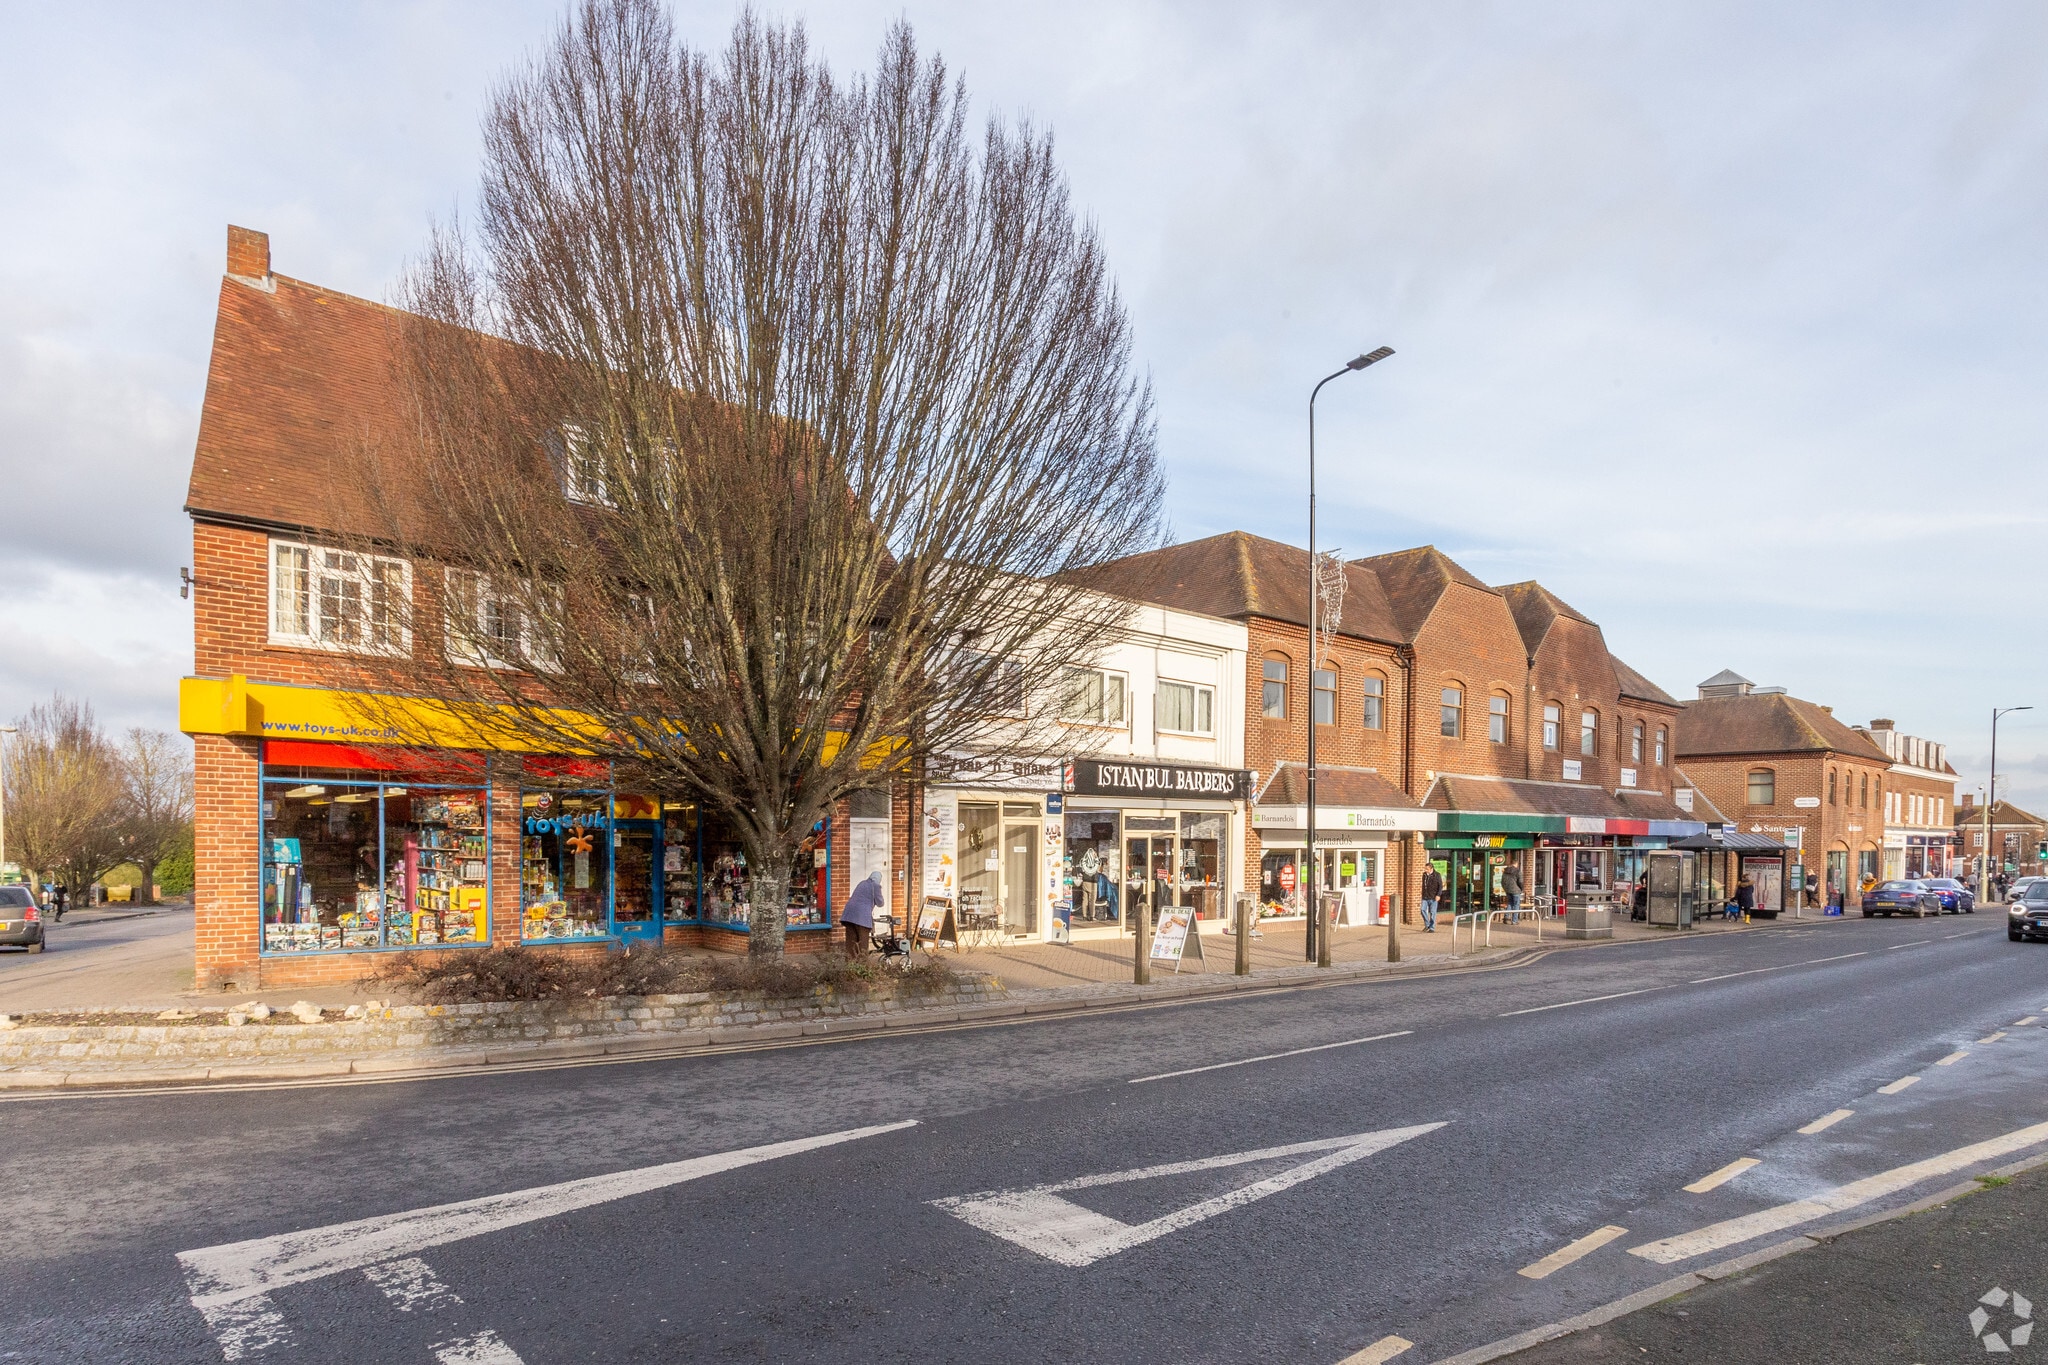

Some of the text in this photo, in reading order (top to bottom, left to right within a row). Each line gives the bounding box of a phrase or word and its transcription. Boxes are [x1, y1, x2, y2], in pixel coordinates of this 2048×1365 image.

[261, 722, 399, 738] www.toys-uk.co.uk
[1097, 764, 1235, 793] ISTANBUL BARBERS
[1261, 814, 1295, 823] Barnardo's
[1356, 813, 1396, 827] Barnardo's
[1475, 834, 1506, 848] SUBWAY
